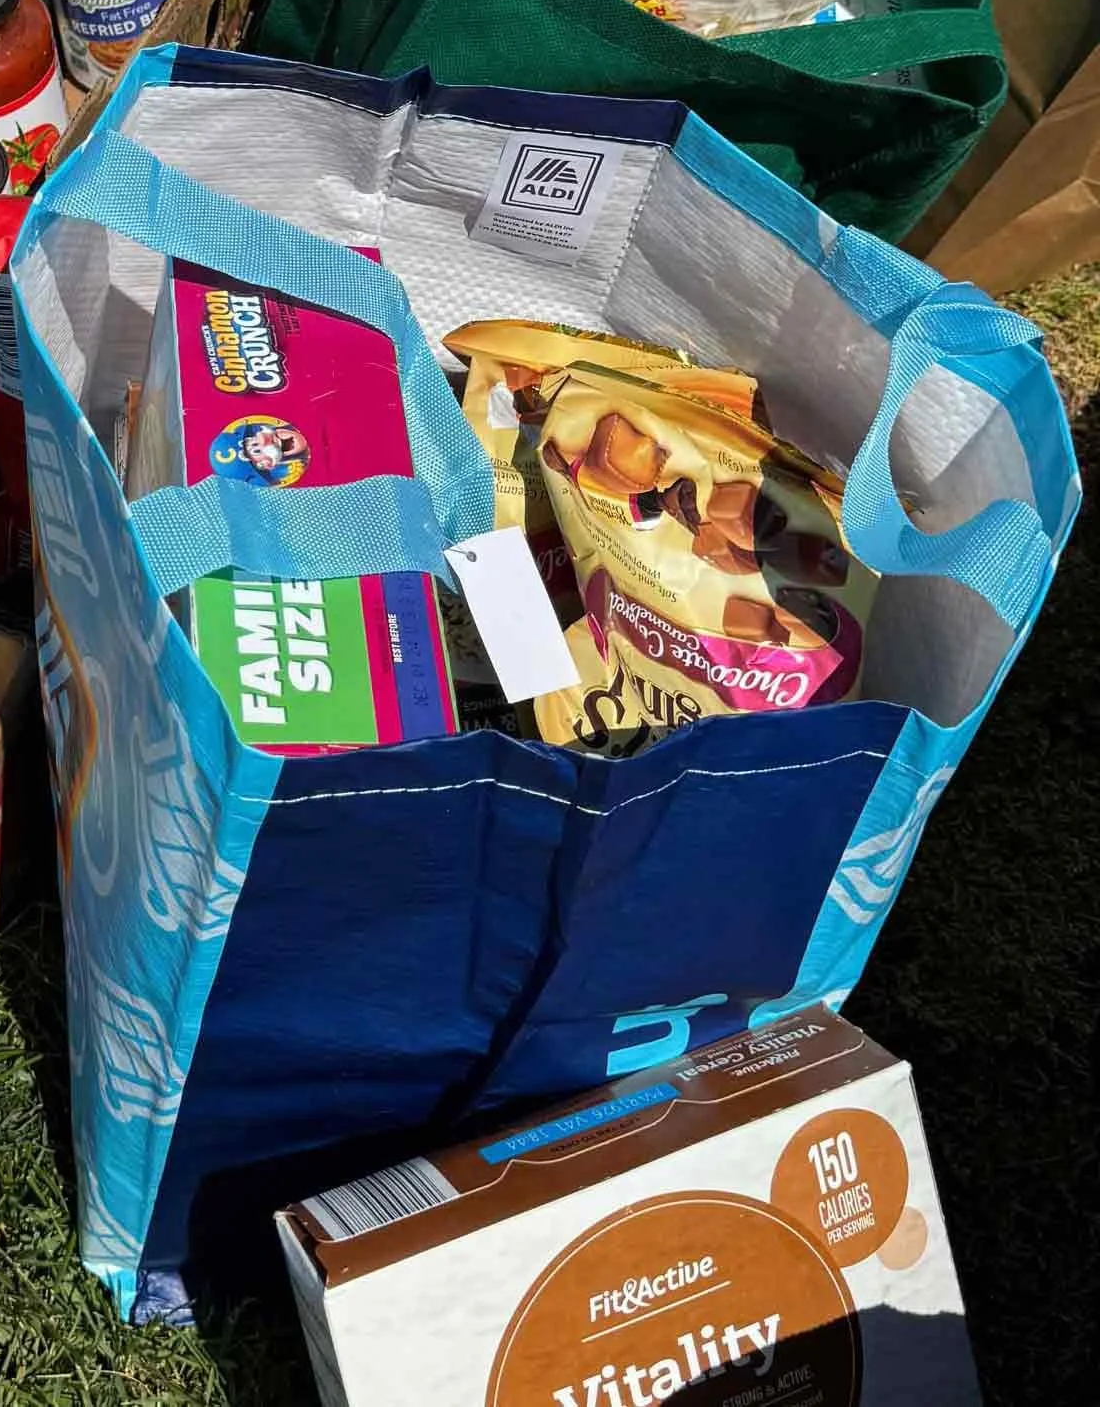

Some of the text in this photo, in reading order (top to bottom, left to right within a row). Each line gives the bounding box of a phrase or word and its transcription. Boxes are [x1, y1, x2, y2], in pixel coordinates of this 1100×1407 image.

[100, 1, 152, 23] Fat Free
[519, 184, 575, 200] ALDI
[206, 290, 249, 394] Cinnamon
[230, 294, 282, 389] CRUNCH
[290, 577, 335, 693] SIZE
[394, 638, 404, 664] BEST
[671, 643, 810, 706] Chocolate
[675, 1021, 827, 1083] Vitality Cereal
[806, 1129, 860, 1197] 150
[818, 1184, 872, 1231] CALORIES
[825, 1212, 875, 1246] PER SERVING
[554, 1311, 783, 1407] Vitality
